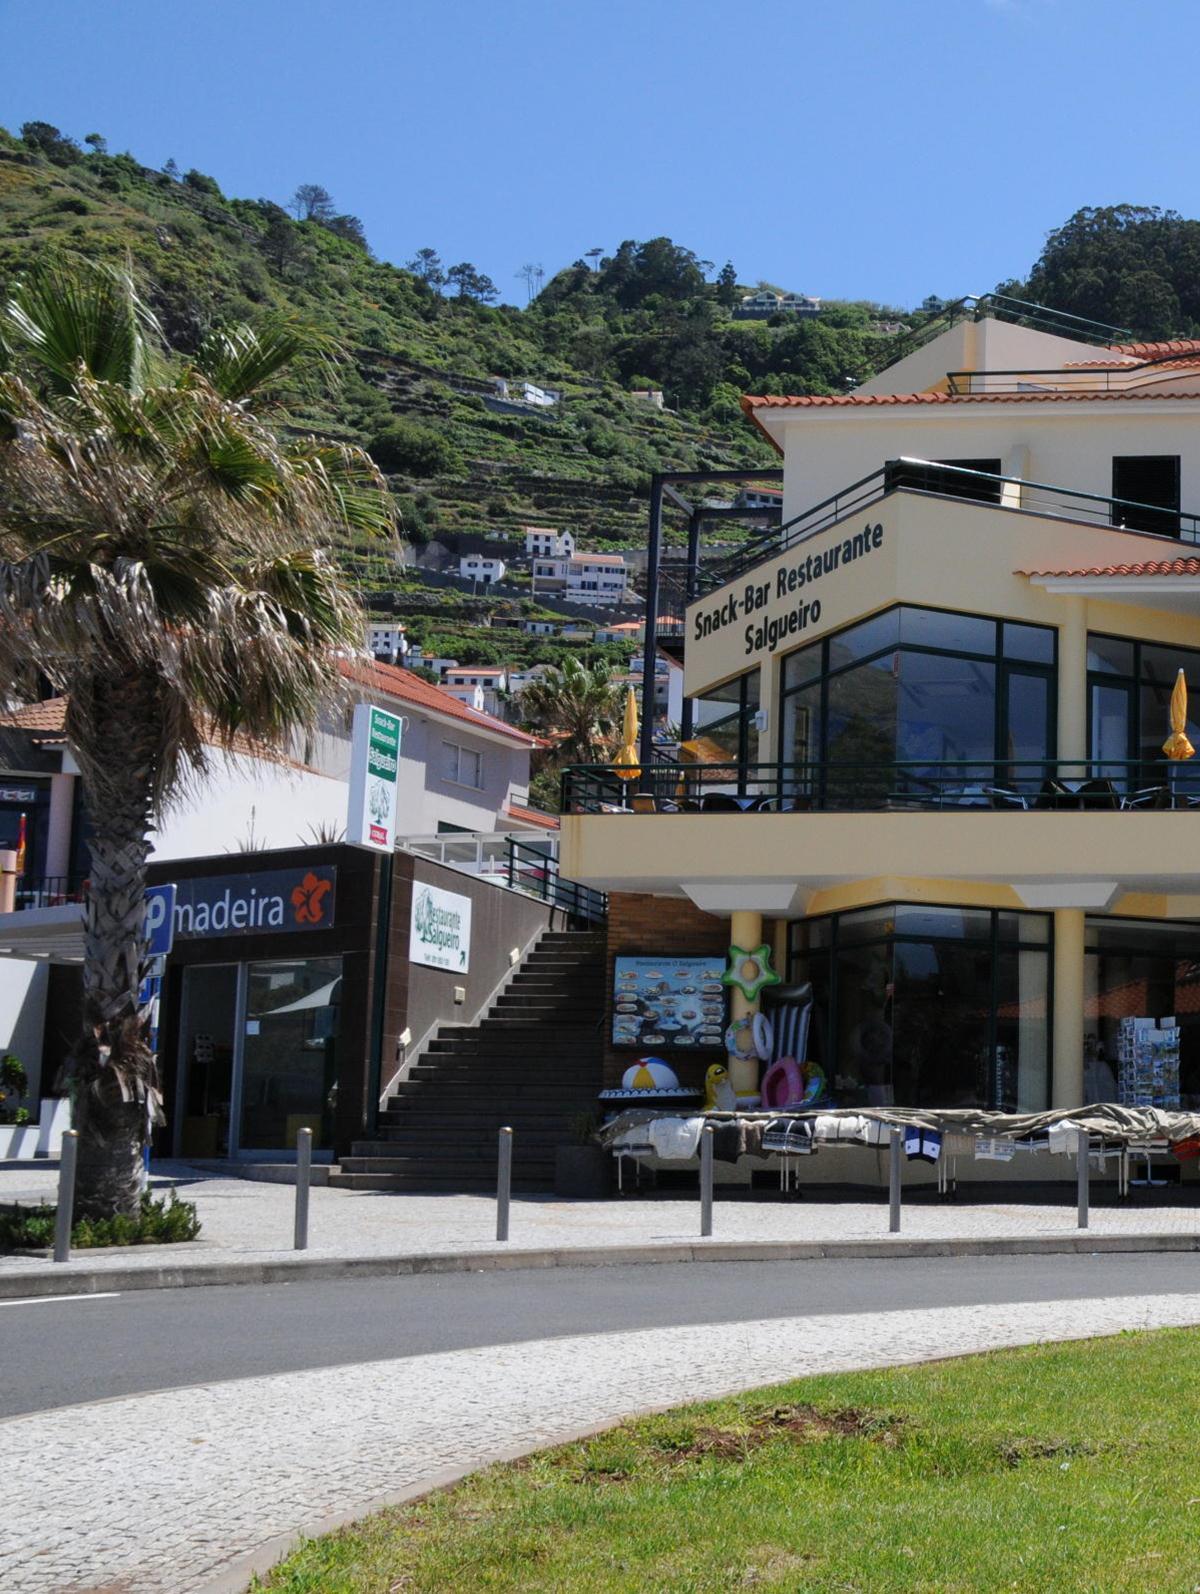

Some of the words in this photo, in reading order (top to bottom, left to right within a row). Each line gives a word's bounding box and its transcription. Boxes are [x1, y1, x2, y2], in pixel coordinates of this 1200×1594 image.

[694, 580, 770, 641] Snack-Bar
[776, 522, 883, 599] Restaurante
[745, 599, 821, 655] Salgueiro
[369, 746, 397, 773] Salgueiro
[145, 895, 165, 939] P
[174, 888, 284, 932] madeira
[428, 922, 459, 951] Salgueiro
